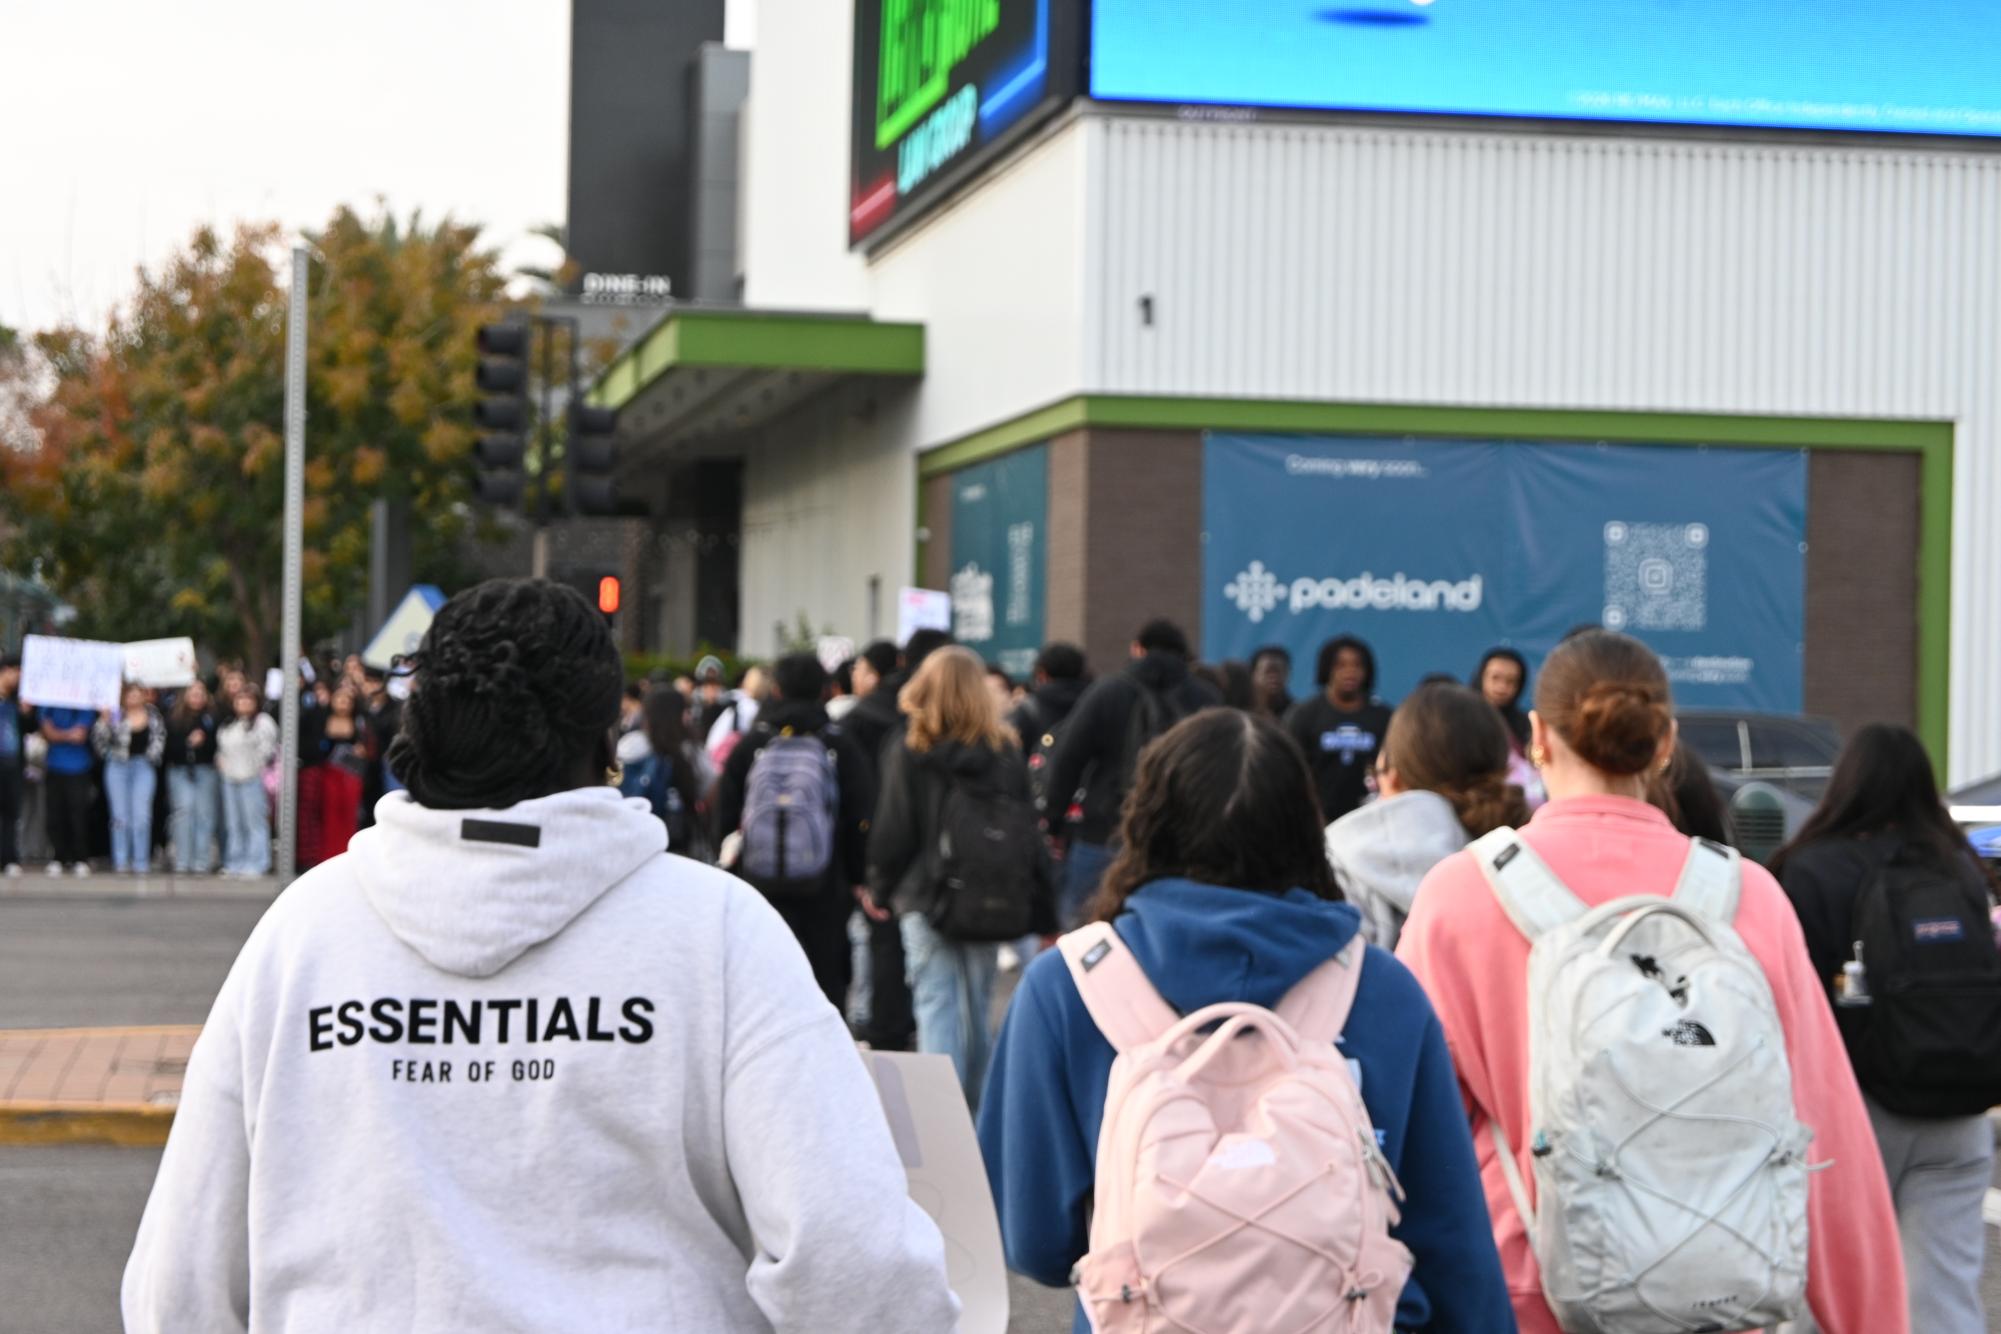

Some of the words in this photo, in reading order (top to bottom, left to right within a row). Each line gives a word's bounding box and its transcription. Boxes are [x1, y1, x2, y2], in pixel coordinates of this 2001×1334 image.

[583, 272, 671, 295] DINE-IN
[1285, 454, 1344, 480] Coming
[1348, 458, 1380, 480] very
[309, 996, 655, 1052] ESSENTIALS
[392, 1059, 452, 1083] FEAR
[468, 1060, 496, 1082] OF
[511, 1058, 556, 1082] GOD
